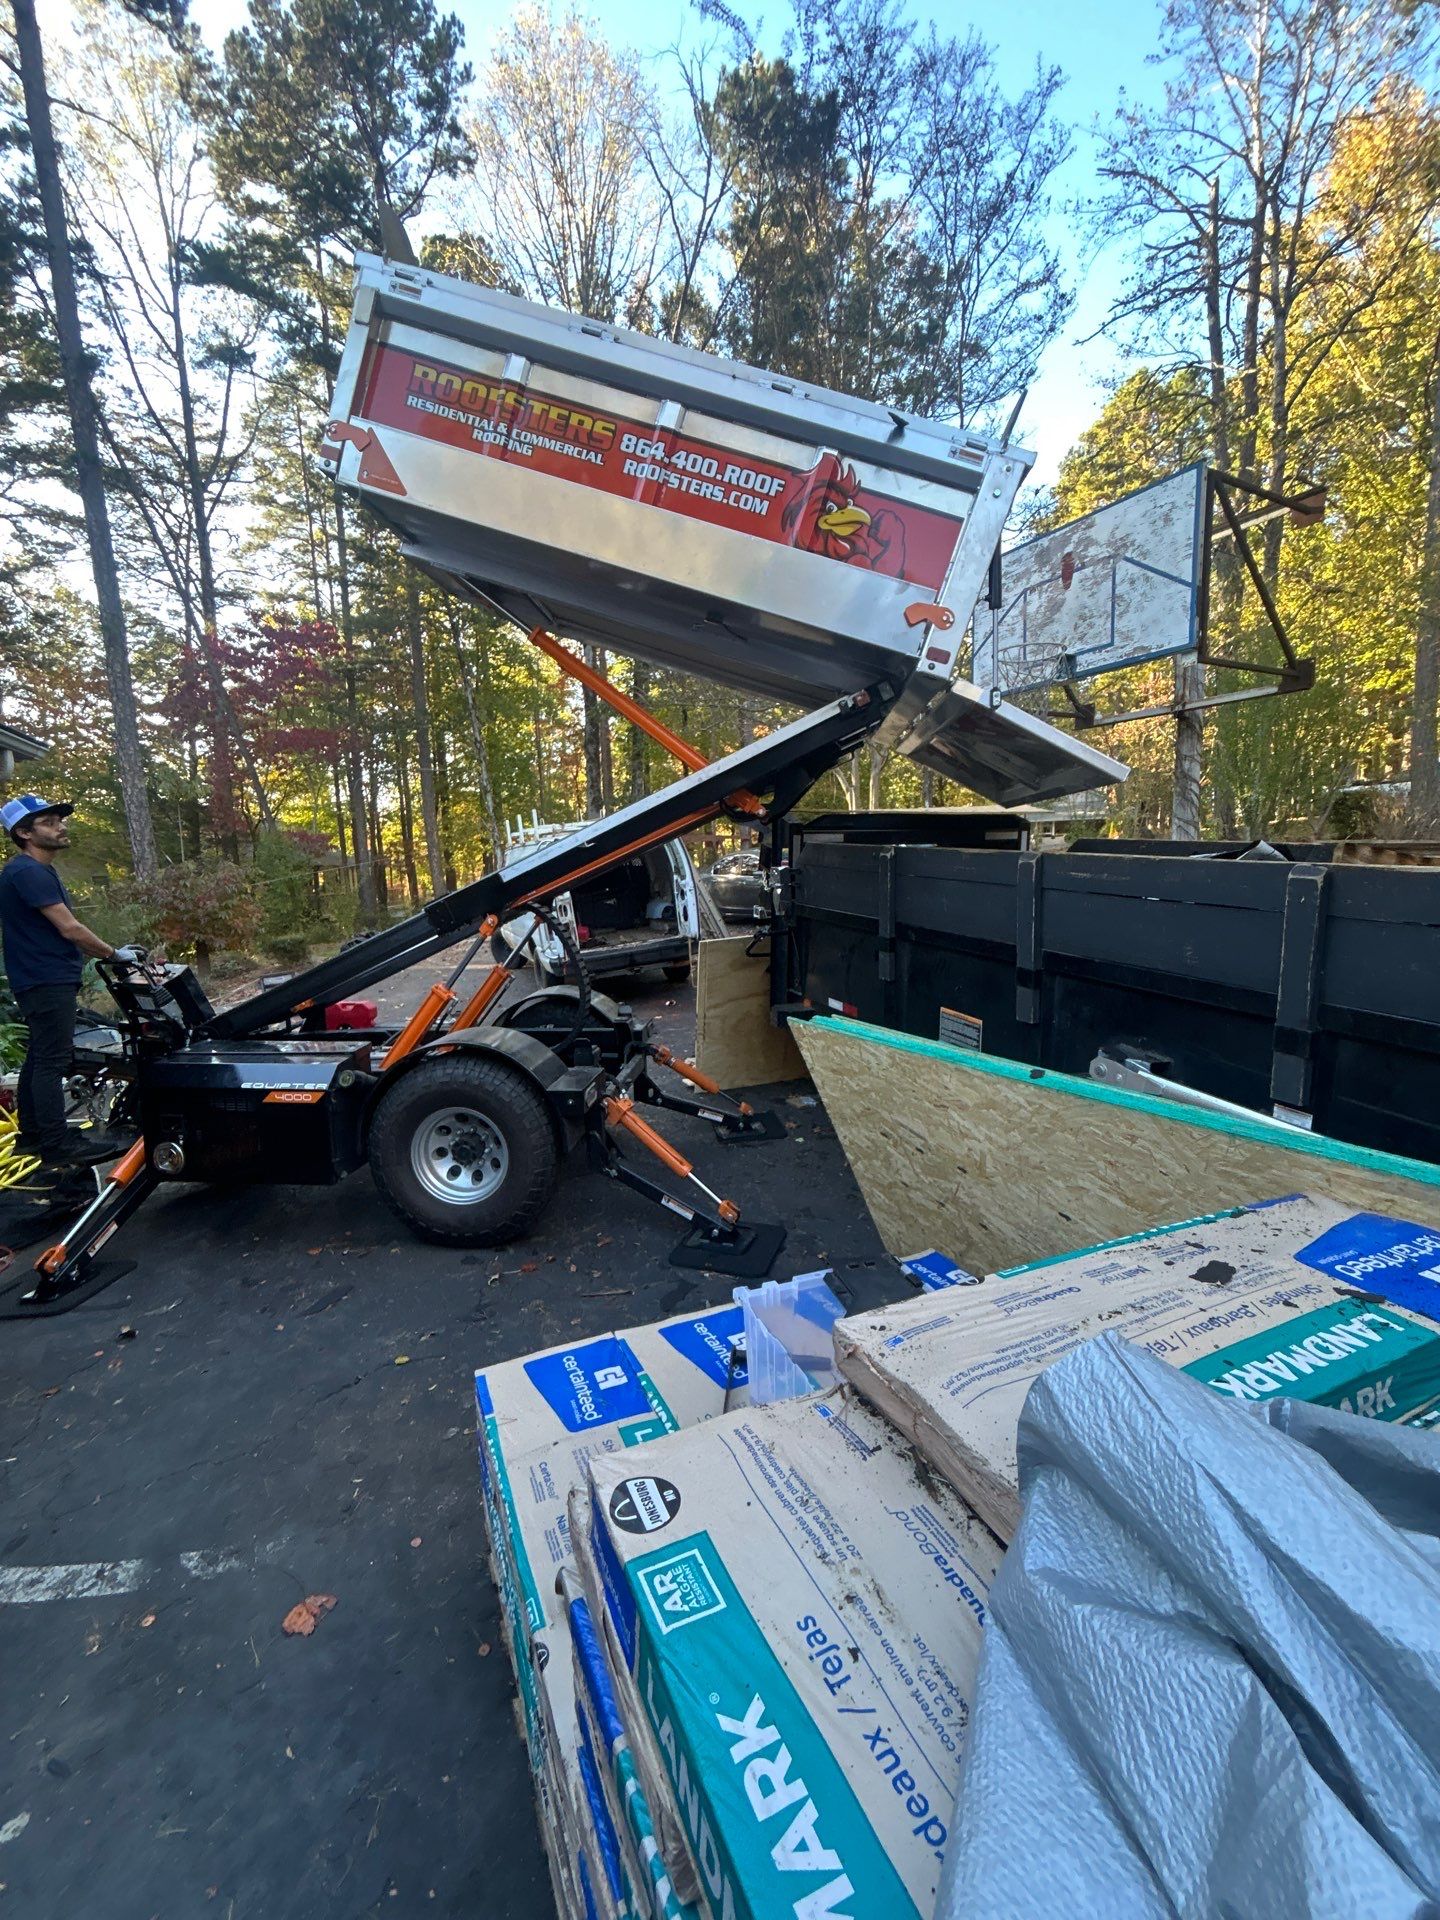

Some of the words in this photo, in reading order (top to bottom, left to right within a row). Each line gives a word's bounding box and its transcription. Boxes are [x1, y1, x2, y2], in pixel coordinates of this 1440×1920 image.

[407, 395, 494, 430] RESIDENTIAL
[498, 423, 508, 434] &
[512, 429, 604, 465] COMMERCIAL
[472, 429, 534, 456] ROOFING
[620, 433, 786, 497] 864.400.ROOF
[623, 459, 770, 516] ROOFSTERS.COM
[241, 1082, 328, 1090] EQUIPTER
[275, 1093, 312, 1101] 4000
[1335, 1234, 1440, 1280] ertainteed
[1004, 1287, 1081, 1317] QuadraBond
[1207, 1312, 1405, 1400] LANDMARK
[563, 1355, 602, 1421] certainteed
[733, 1428, 778, 1490] approximadamente
[634, 1481, 662, 1524] JONESBURG
[663, 1489, 677, 1502] MO
[774, 1489, 798, 1517] cubren
[813, 1515, 838, 1546] square
[653, 1570, 690, 1612] AR
[672, 1565, 699, 1608] ALGAE
[683, 1564, 707, 1606] RESISTANT
[796, 1615, 852, 1697] Tejas
[881, 1638, 914, 1687] environ
[910, 1687, 956, 1752] couvrent
[933, 1696, 953, 1718] 9.2
